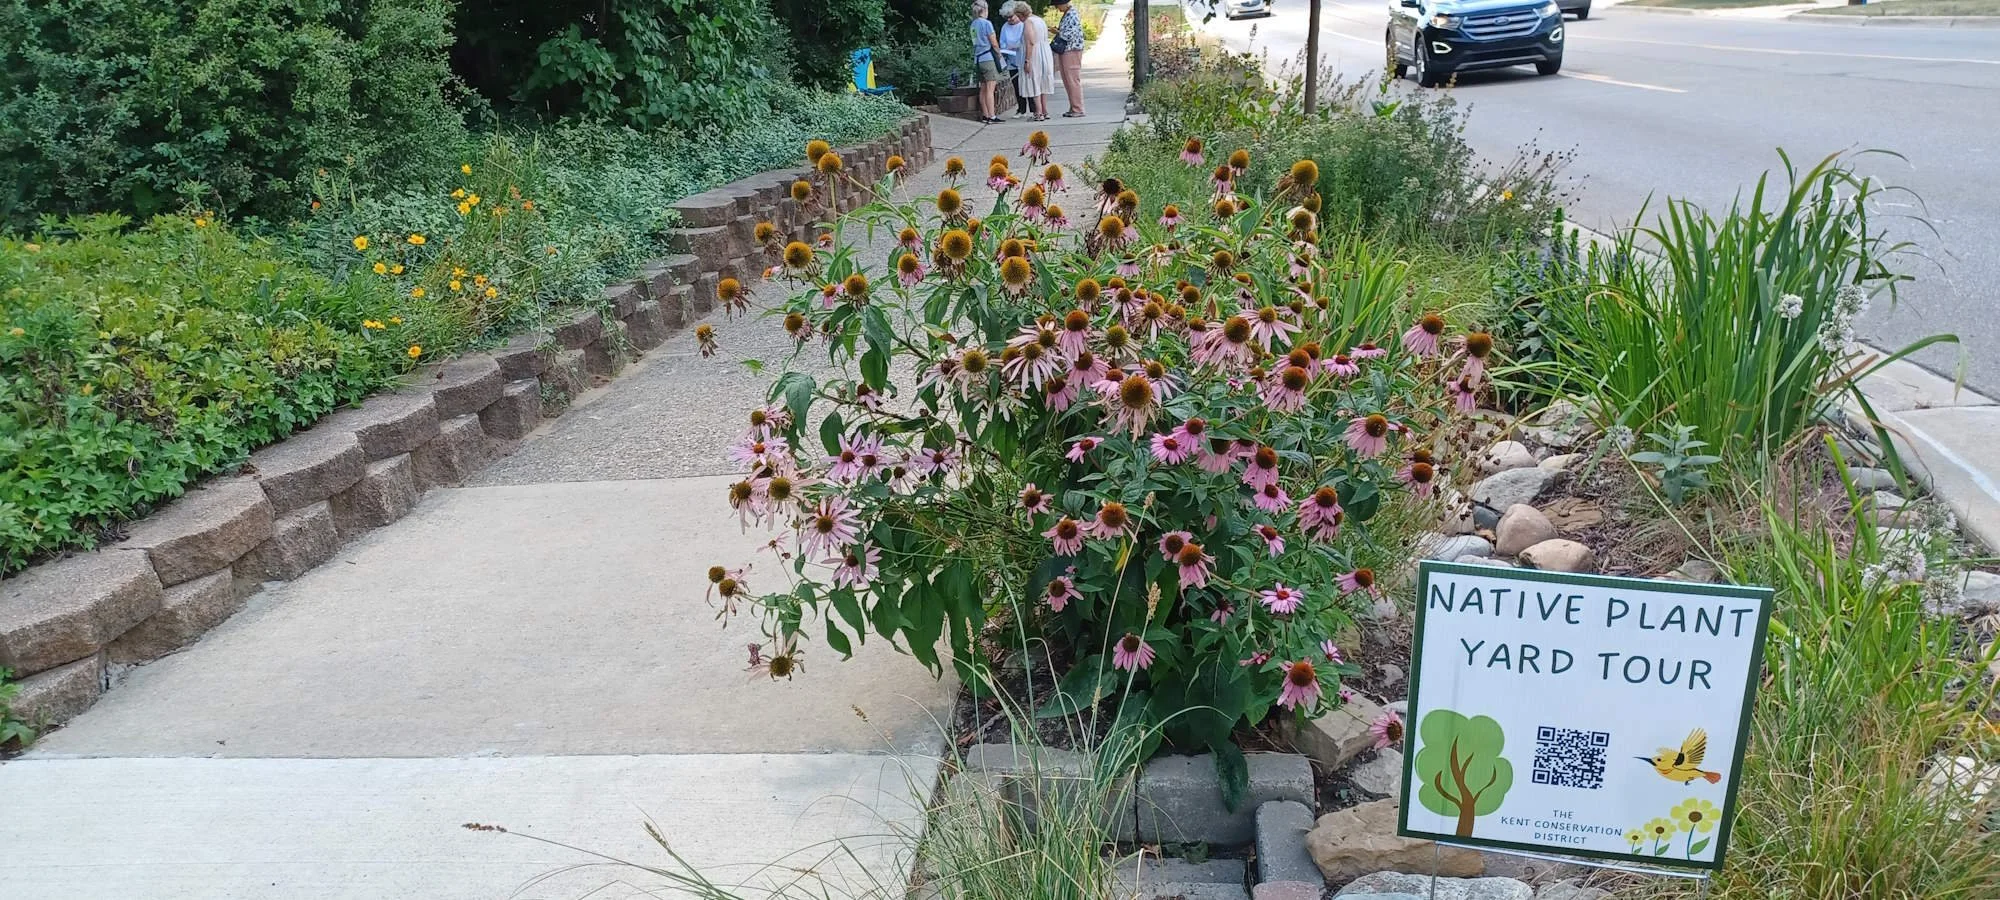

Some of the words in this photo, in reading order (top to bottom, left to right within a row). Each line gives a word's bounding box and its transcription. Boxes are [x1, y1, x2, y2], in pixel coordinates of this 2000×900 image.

[1429, 581, 1585, 625] NATIVE
[1606, 597, 1754, 638] PLANT
[1460, 637, 1575, 675] YARD
[1598, 652, 1713, 690] TOUR
[1552, 809, 1575, 820] THE
[1500, 816, 1531, 827] KENT
[1534, 820, 1623, 836] CONSERVATION
[1534, 832, 1587, 845] DISTRICT
